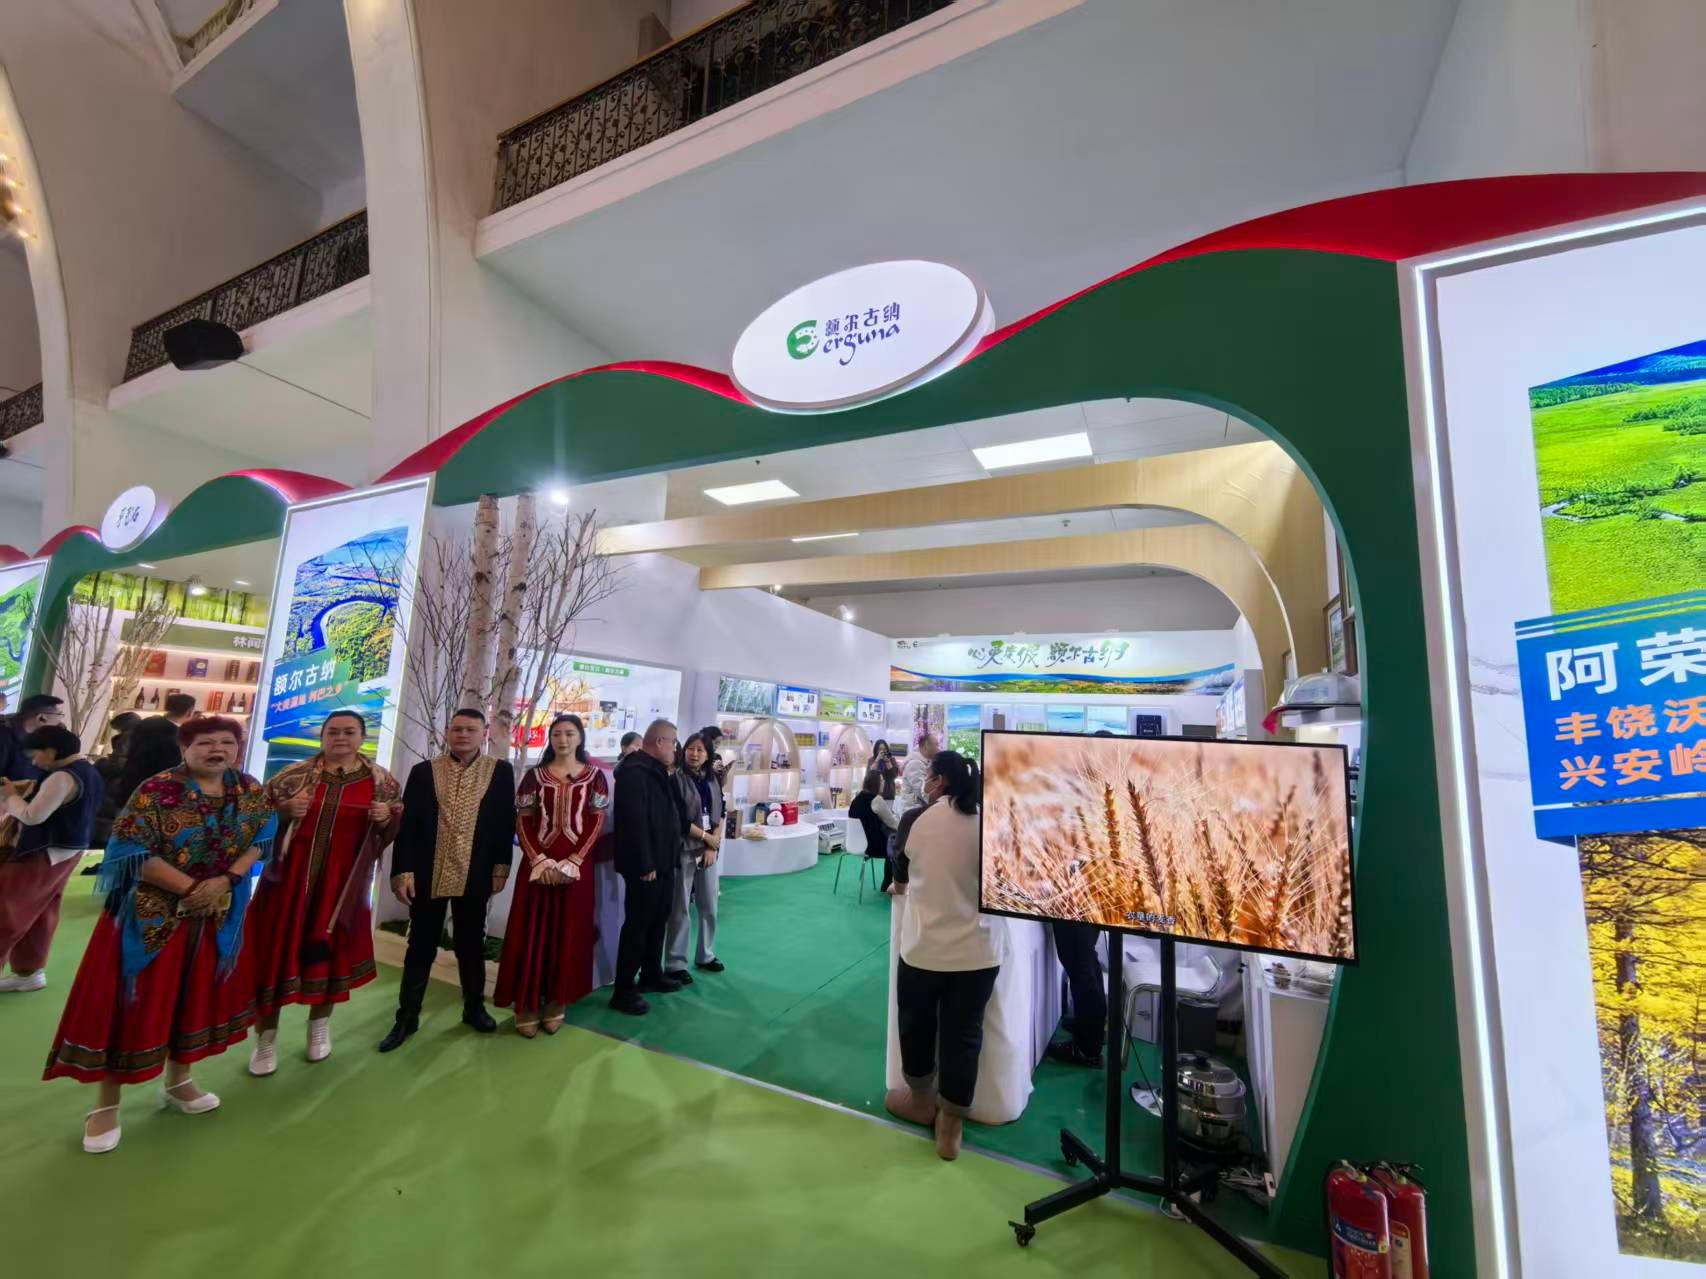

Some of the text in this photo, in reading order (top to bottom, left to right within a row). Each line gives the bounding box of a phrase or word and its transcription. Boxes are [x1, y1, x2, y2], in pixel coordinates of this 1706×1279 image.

[824, 302, 901, 336] 额尔古纳
[823, 323, 901, 366] erguna
[233, 636, 264, 649] 林间
[1045, 640, 1131, 668] 额尔古纳
[273, 659, 336, 696] 额尔古纳
[1545, 627, 1706, 701] 阿荣
[1555, 695, 1706, 745] 丰饶沃
[1559, 739, 1706, 791] 兴安岭
